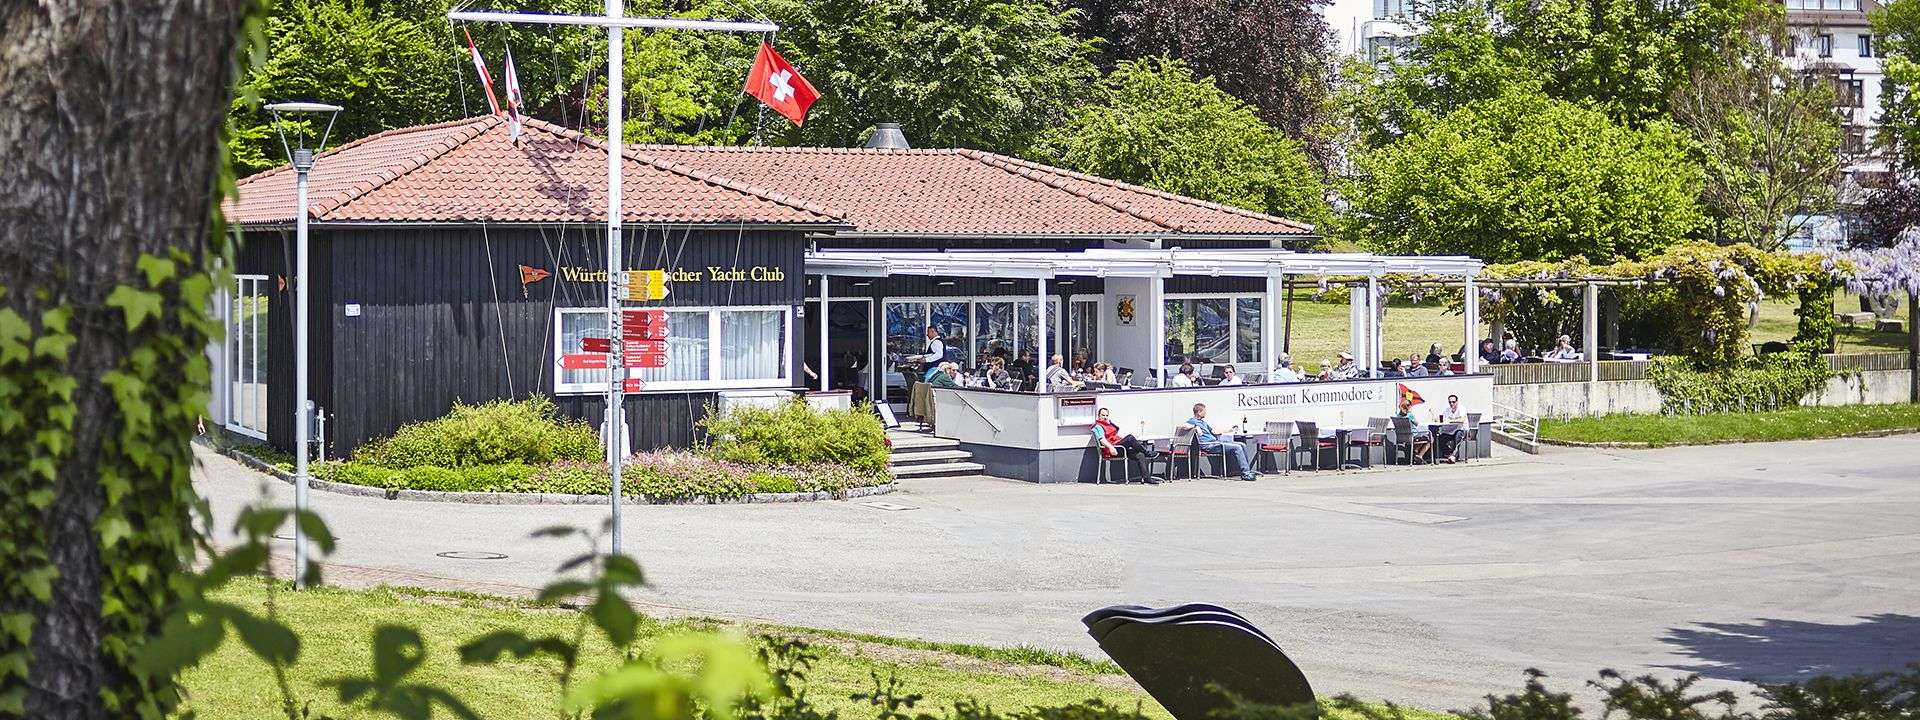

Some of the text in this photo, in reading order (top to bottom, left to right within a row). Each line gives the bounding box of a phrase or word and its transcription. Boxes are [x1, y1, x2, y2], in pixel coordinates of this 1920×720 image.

[560, 266, 703, 282] Württscher
[707, 266, 746, 281] Yacht
[750, 266, 785, 281] Club
[1237, 387, 1374, 407] Restaurant Kommodore
